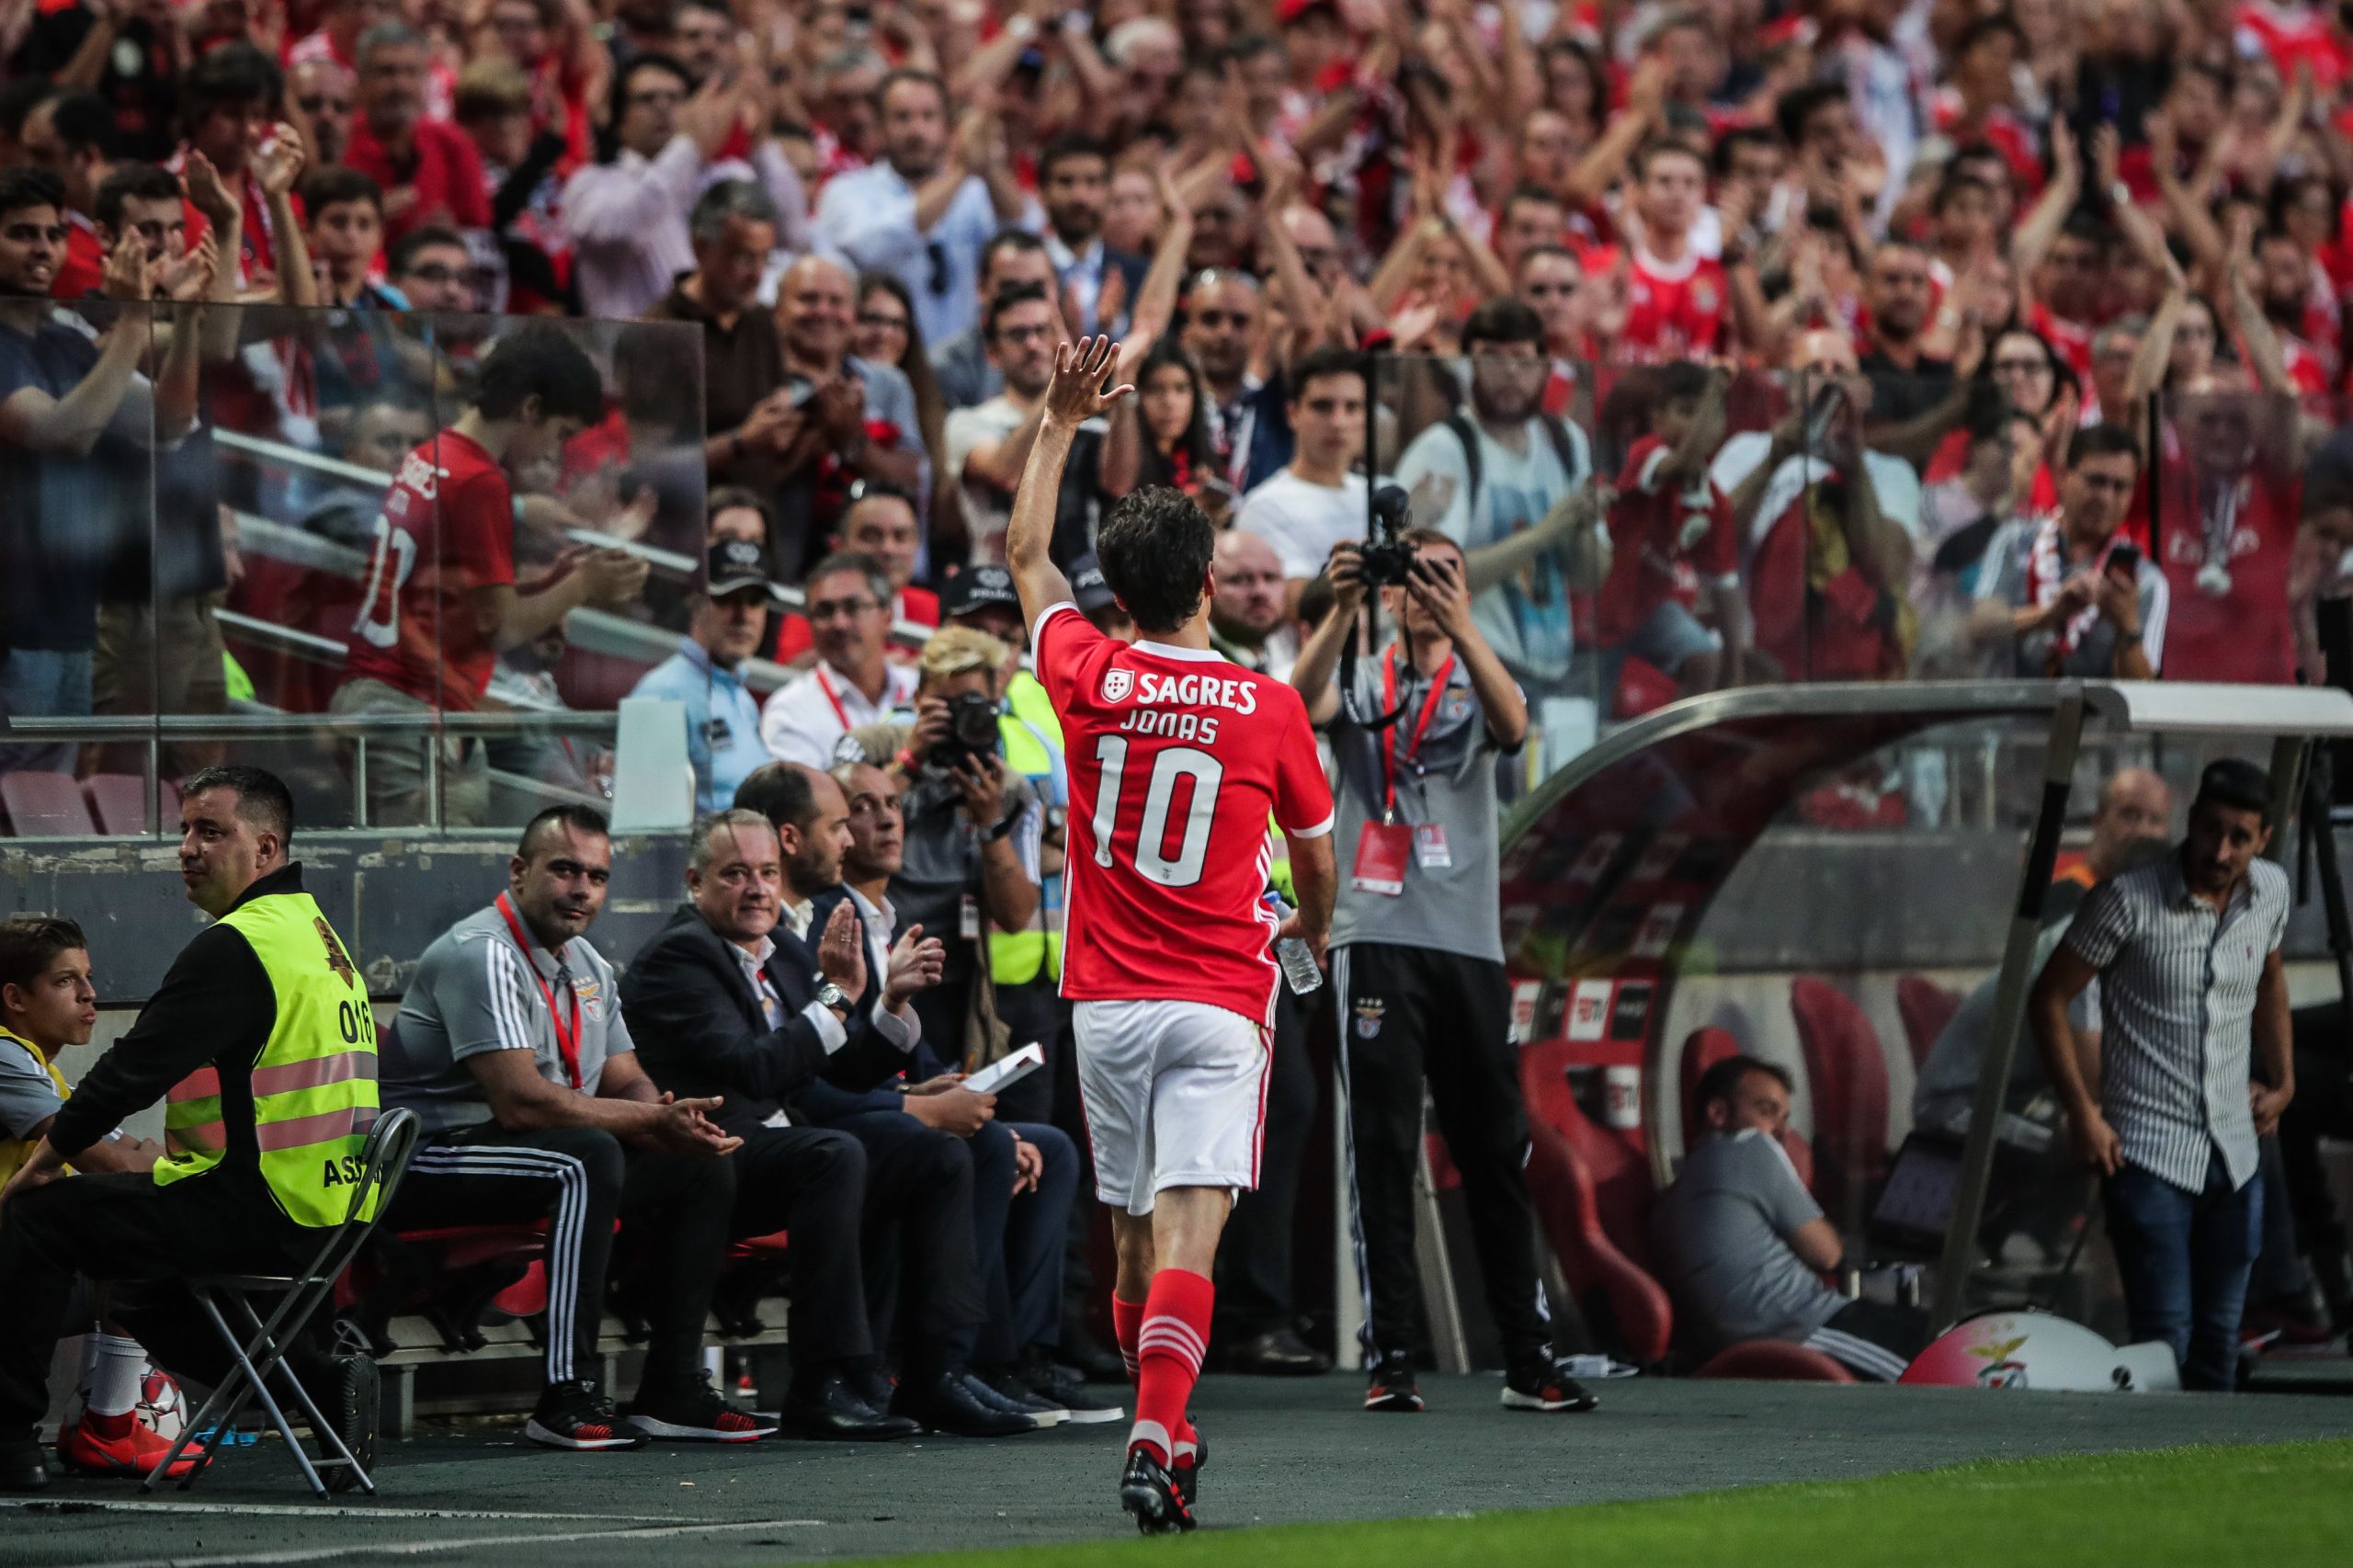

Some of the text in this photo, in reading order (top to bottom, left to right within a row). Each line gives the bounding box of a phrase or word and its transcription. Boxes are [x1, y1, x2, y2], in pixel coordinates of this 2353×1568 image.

[1137, 674, 1257, 715] SAGRES
[1120, 710, 1219, 745] JONAS
[1092, 734, 1224, 887] 10
[338, 999, 372, 1045] 016
